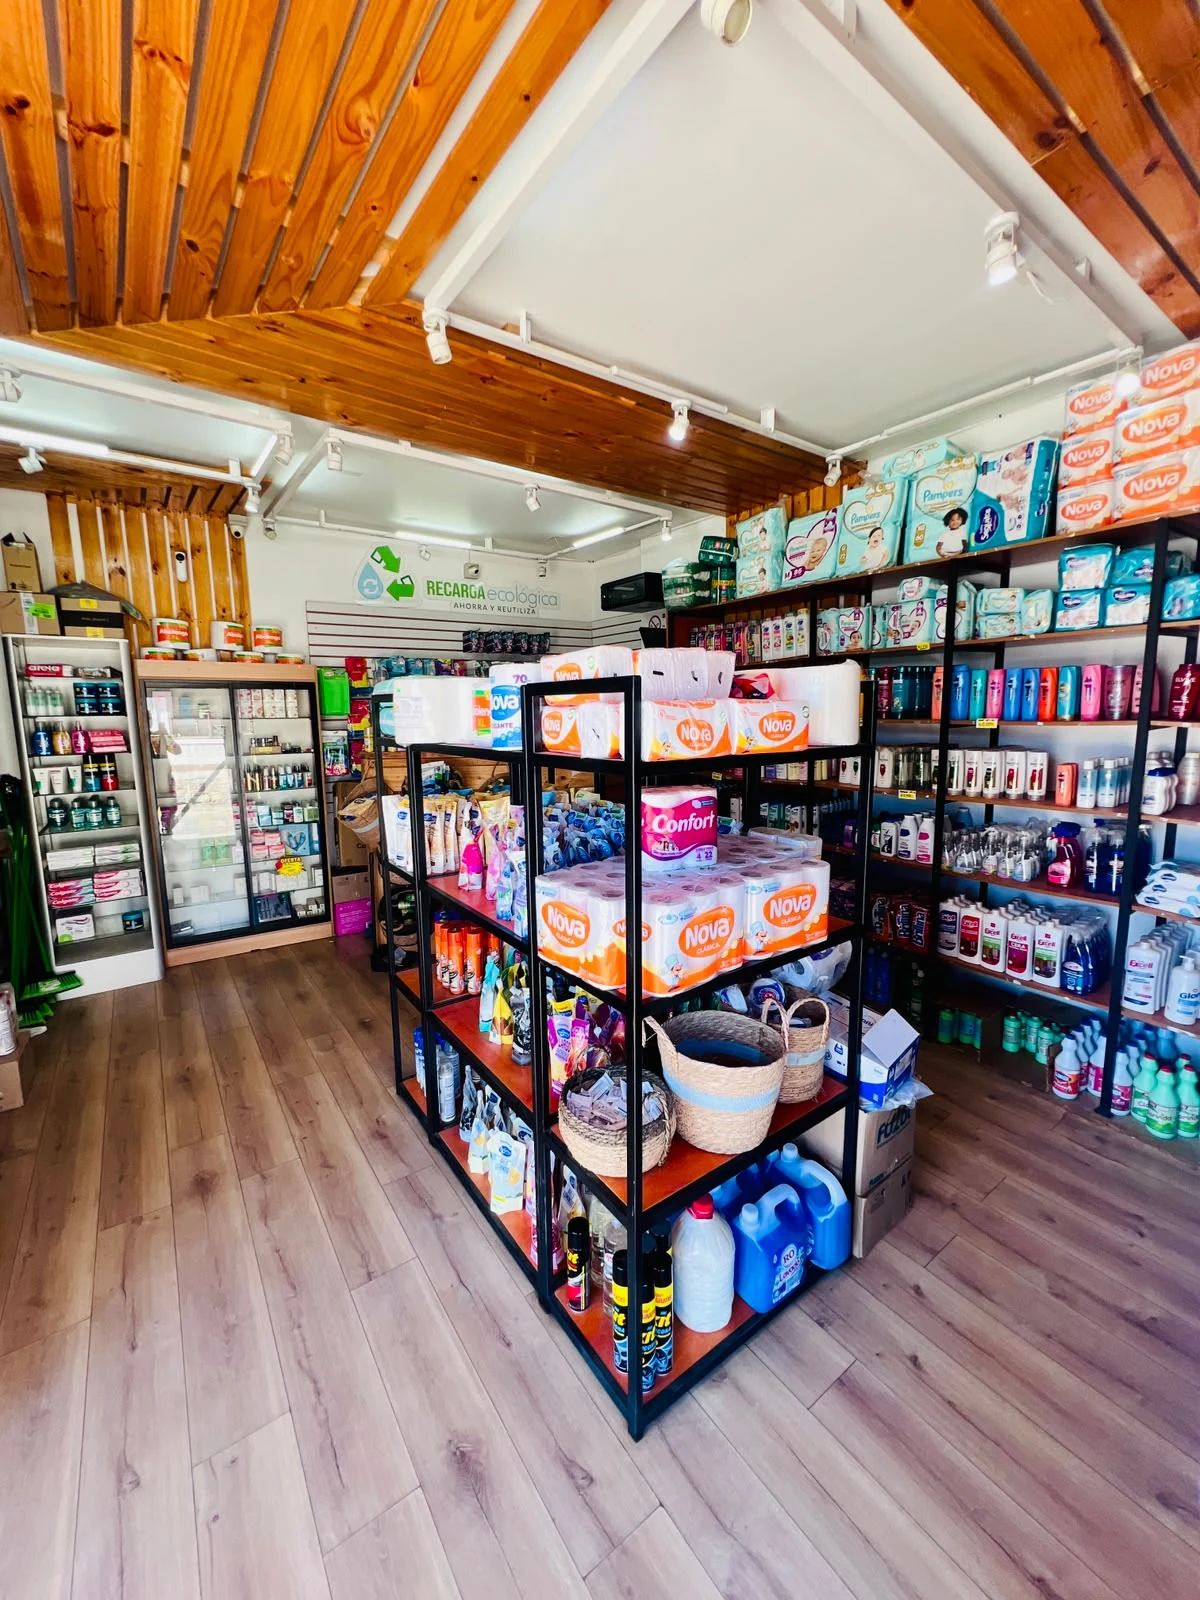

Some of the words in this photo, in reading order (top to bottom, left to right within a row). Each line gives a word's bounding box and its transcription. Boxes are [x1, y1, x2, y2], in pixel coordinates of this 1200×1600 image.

[1145, 357, 1196, 385] Nova
[1074, 390, 1113, 412] Nova
[1129, 413, 1180, 439] Nova
[1067, 446, 1105, 464] Nova
[1129, 472, 1180, 496] Nova
[923, 488, 963, 503] Pampers
[1065, 500, 1103, 516] Nova
[851, 511, 881, 525] Pampers
[426, 580, 486, 600] RECARGA
[487, 584, 558, 609] ecológica
[453, 602, 488, 612] AHORRA
[497, 606, 536, 615] REUTILIZA
[512, 674, 528, 684] 70
[681, 724, 712, 741] Nova
[763, 717, 793, 733] Nova
[652, 810, 716, 834] Confort
[704, 851, 713, 859] 22
[770, 894, 812, 920] Nova
[547, 905, 585, 940] Nova
[780, 914, 801, 925] CLÁSICA
[685, 918, 731, 950] Nova
[1010, 932, 1027, 942] Excell
[696, 943, 721, 955] CLÁSICA
[1037, 938, 1056, 948] Excell
[1129, 960, 1153, 969] Excell
